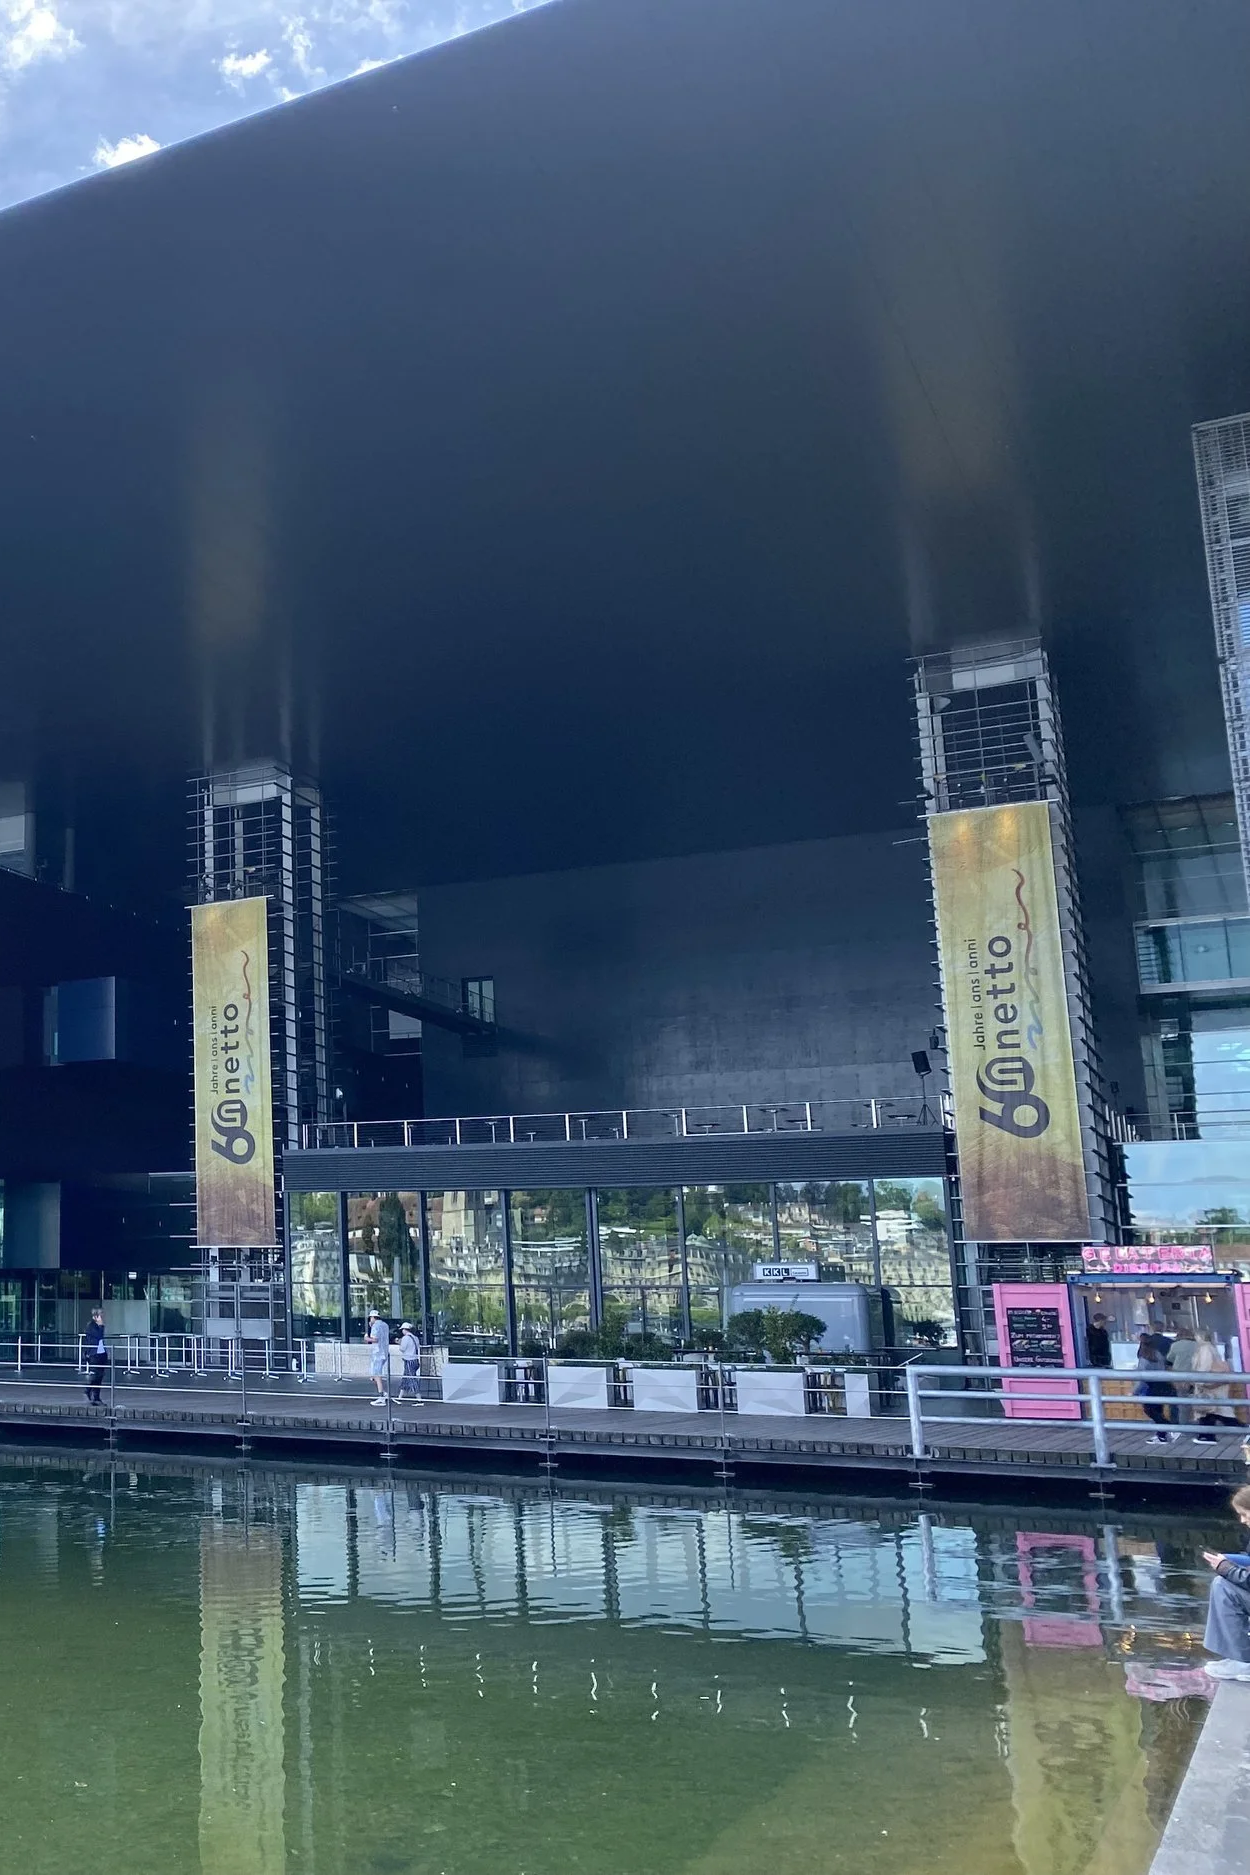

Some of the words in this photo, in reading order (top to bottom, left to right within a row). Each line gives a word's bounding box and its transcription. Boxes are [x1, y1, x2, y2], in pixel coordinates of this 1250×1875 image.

[984, 936, 1021, 1049] netto
[220, 1003, 240, 1094] netto
[972, 1012, 986, 1050] Jahre
[763, 1268, 790, 1276] KKL
